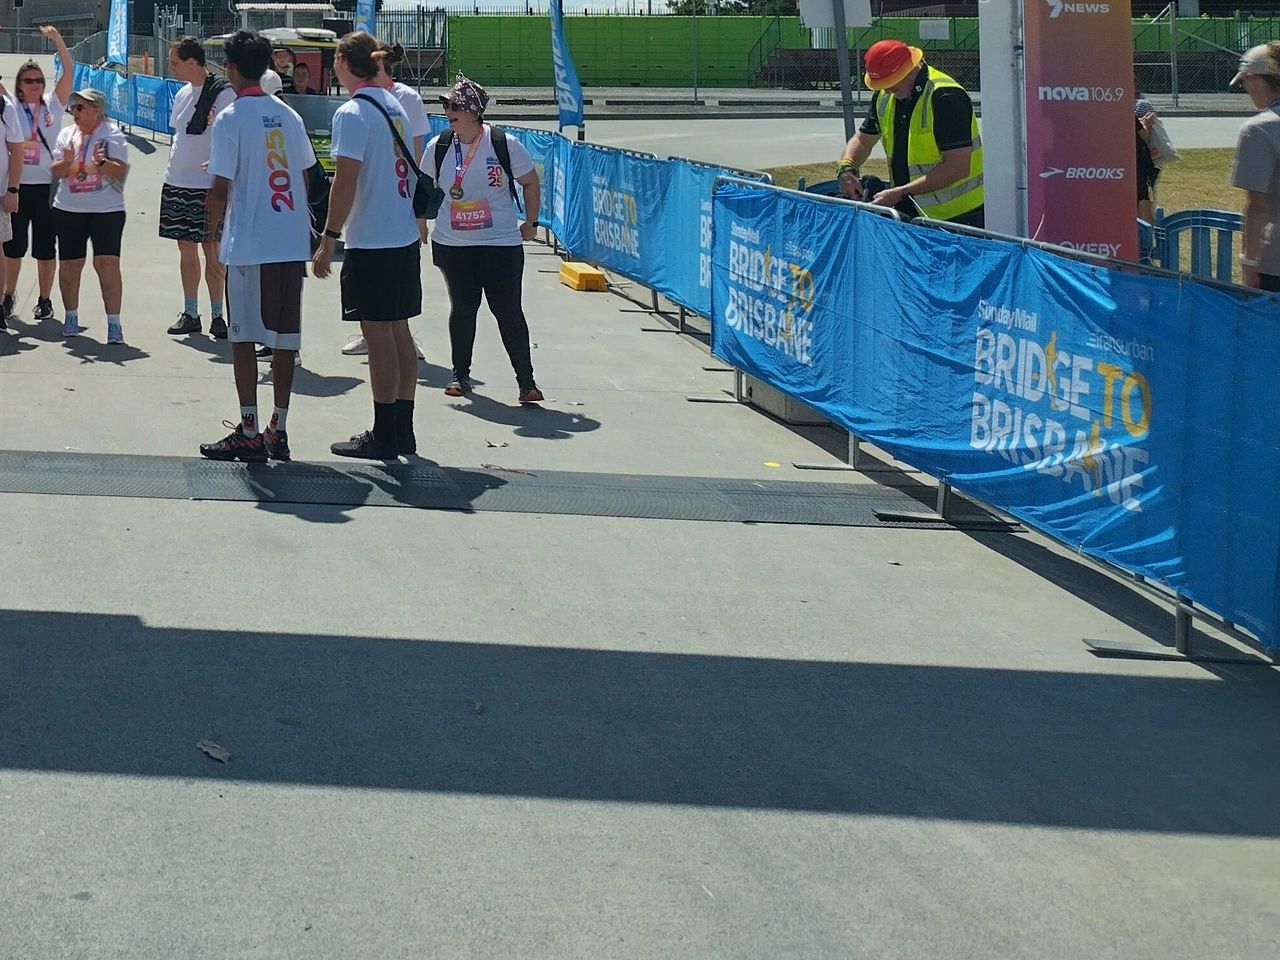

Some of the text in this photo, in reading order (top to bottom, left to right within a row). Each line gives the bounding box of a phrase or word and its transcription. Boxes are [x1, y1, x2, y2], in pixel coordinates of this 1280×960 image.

[266, 129, 295, 213] 2025
[593, 187, 624, 221] BRIDGE
[624, 195, 638, 225] TO
[1065, 167, 1125, 180] BROOKS
[455, 210, 486, 220] 41752
[594, 217, 640, 260] BRISBANE
[729, 240, 789, 304] BRIDGE
[789, 263, 815, 312] TO
[725, 286, 814, 367] BRISBANE
[974, 327, 1153, 438] BRIDGE TO
[969, 391, 1150, 512] BRISBANE
